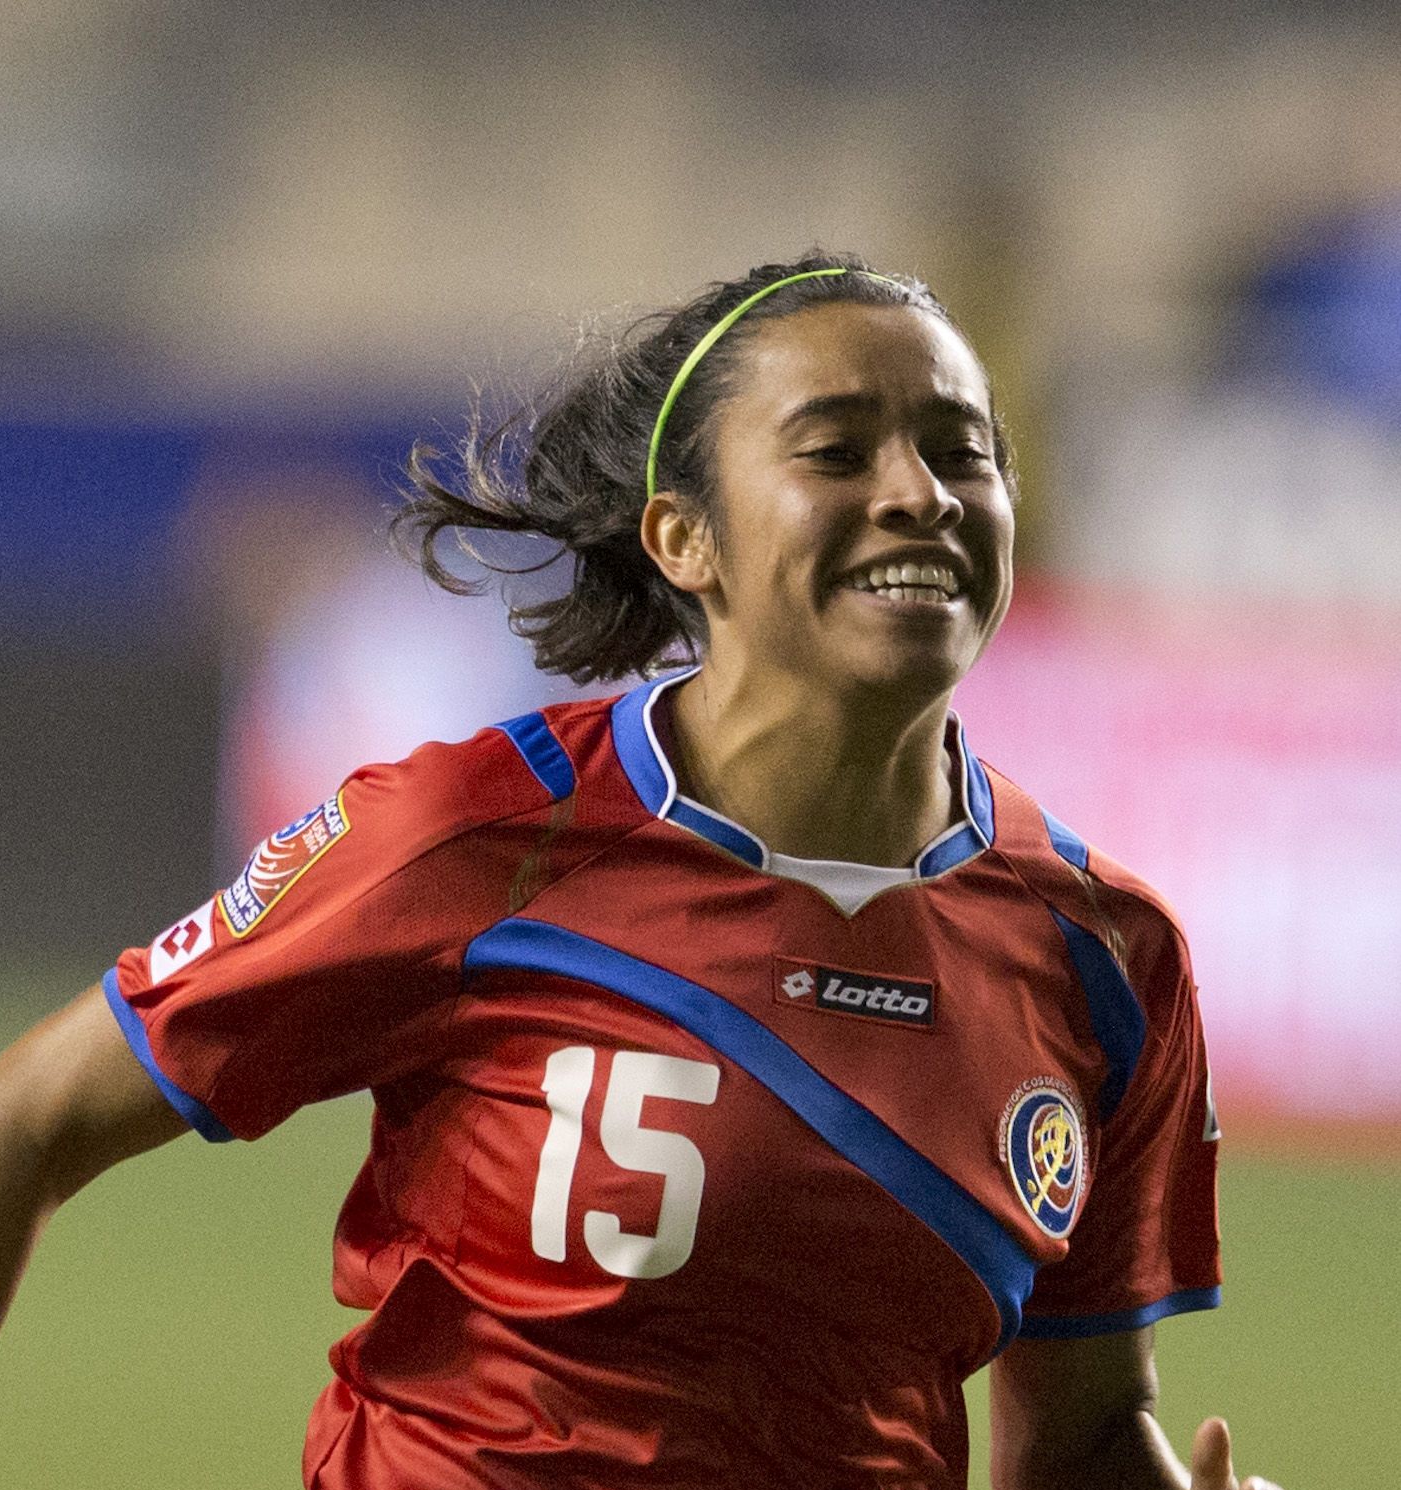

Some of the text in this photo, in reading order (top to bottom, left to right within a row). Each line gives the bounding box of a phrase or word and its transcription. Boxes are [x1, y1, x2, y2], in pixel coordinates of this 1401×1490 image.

[311, 819, 328, 847] USA
[822, 978, 928, 1015] lotto
[531, 1046, 720, 1279] 15
